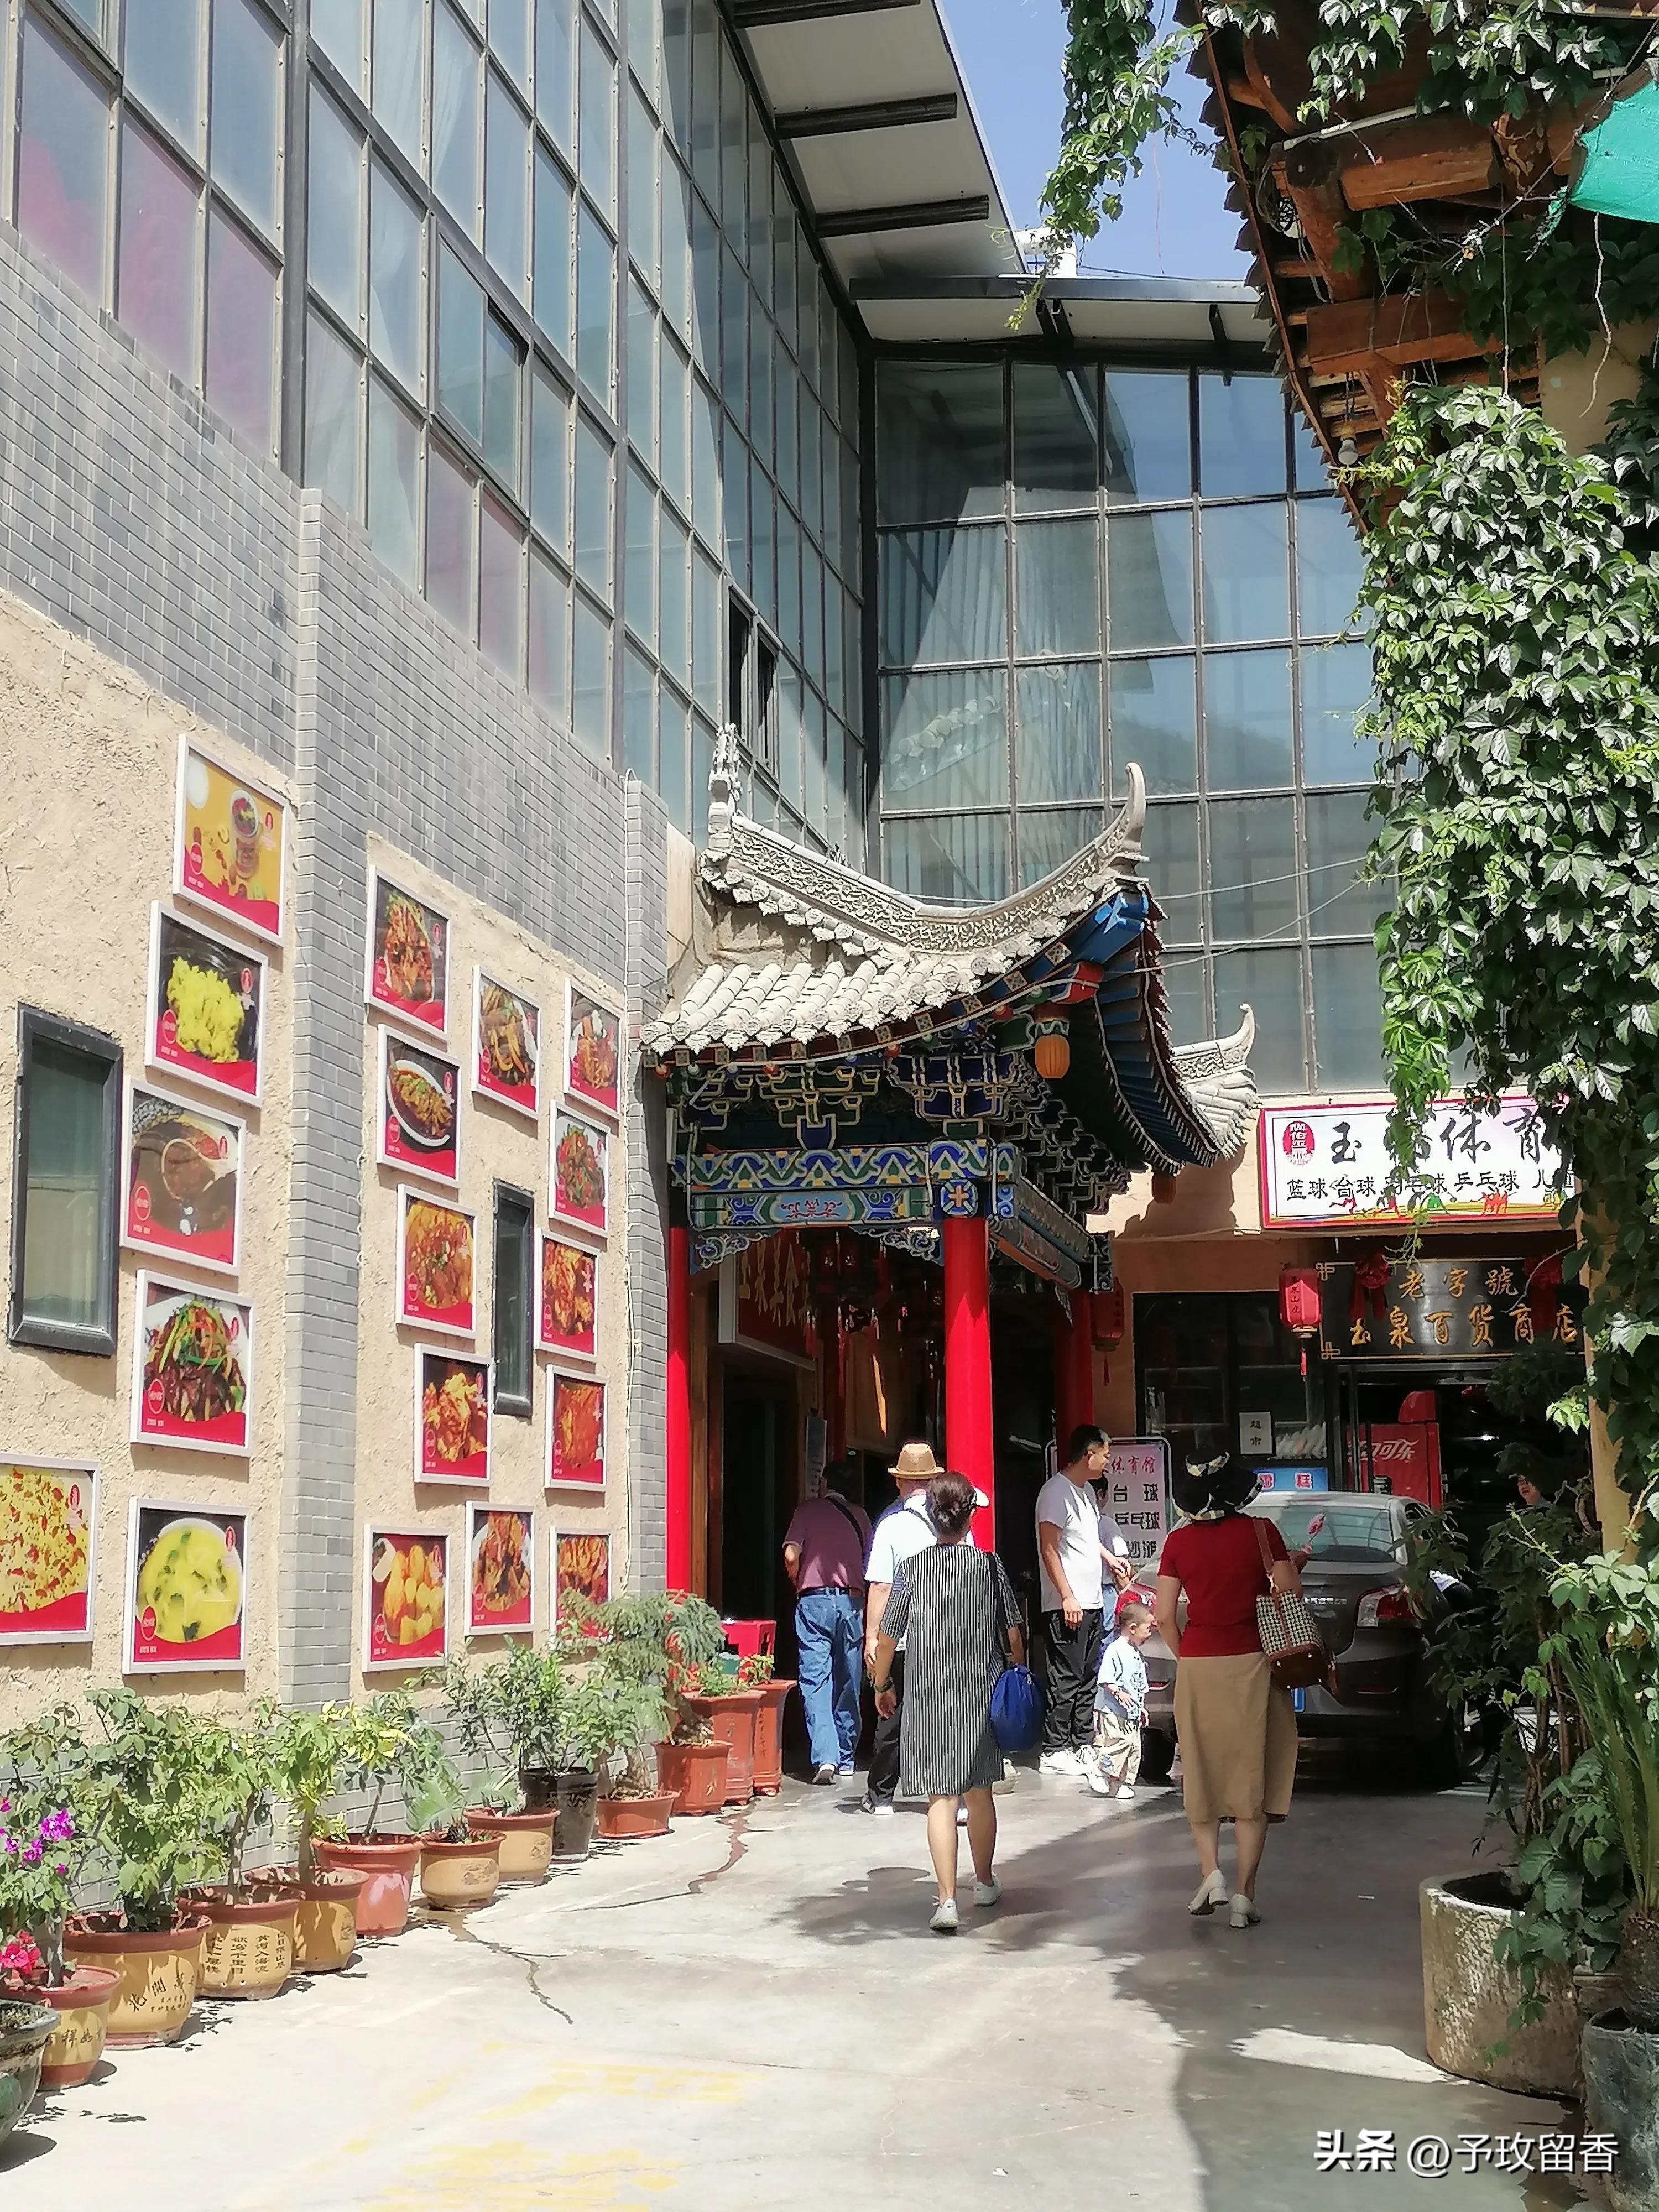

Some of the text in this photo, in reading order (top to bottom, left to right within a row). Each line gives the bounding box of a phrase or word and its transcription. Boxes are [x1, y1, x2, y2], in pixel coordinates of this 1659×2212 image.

[1331, 1108, 1543, 1164] 玉体育
[1454, 1170, 1520, 1193] 乒乓球
[1399, 1267, 1517, 1301] 老字號
